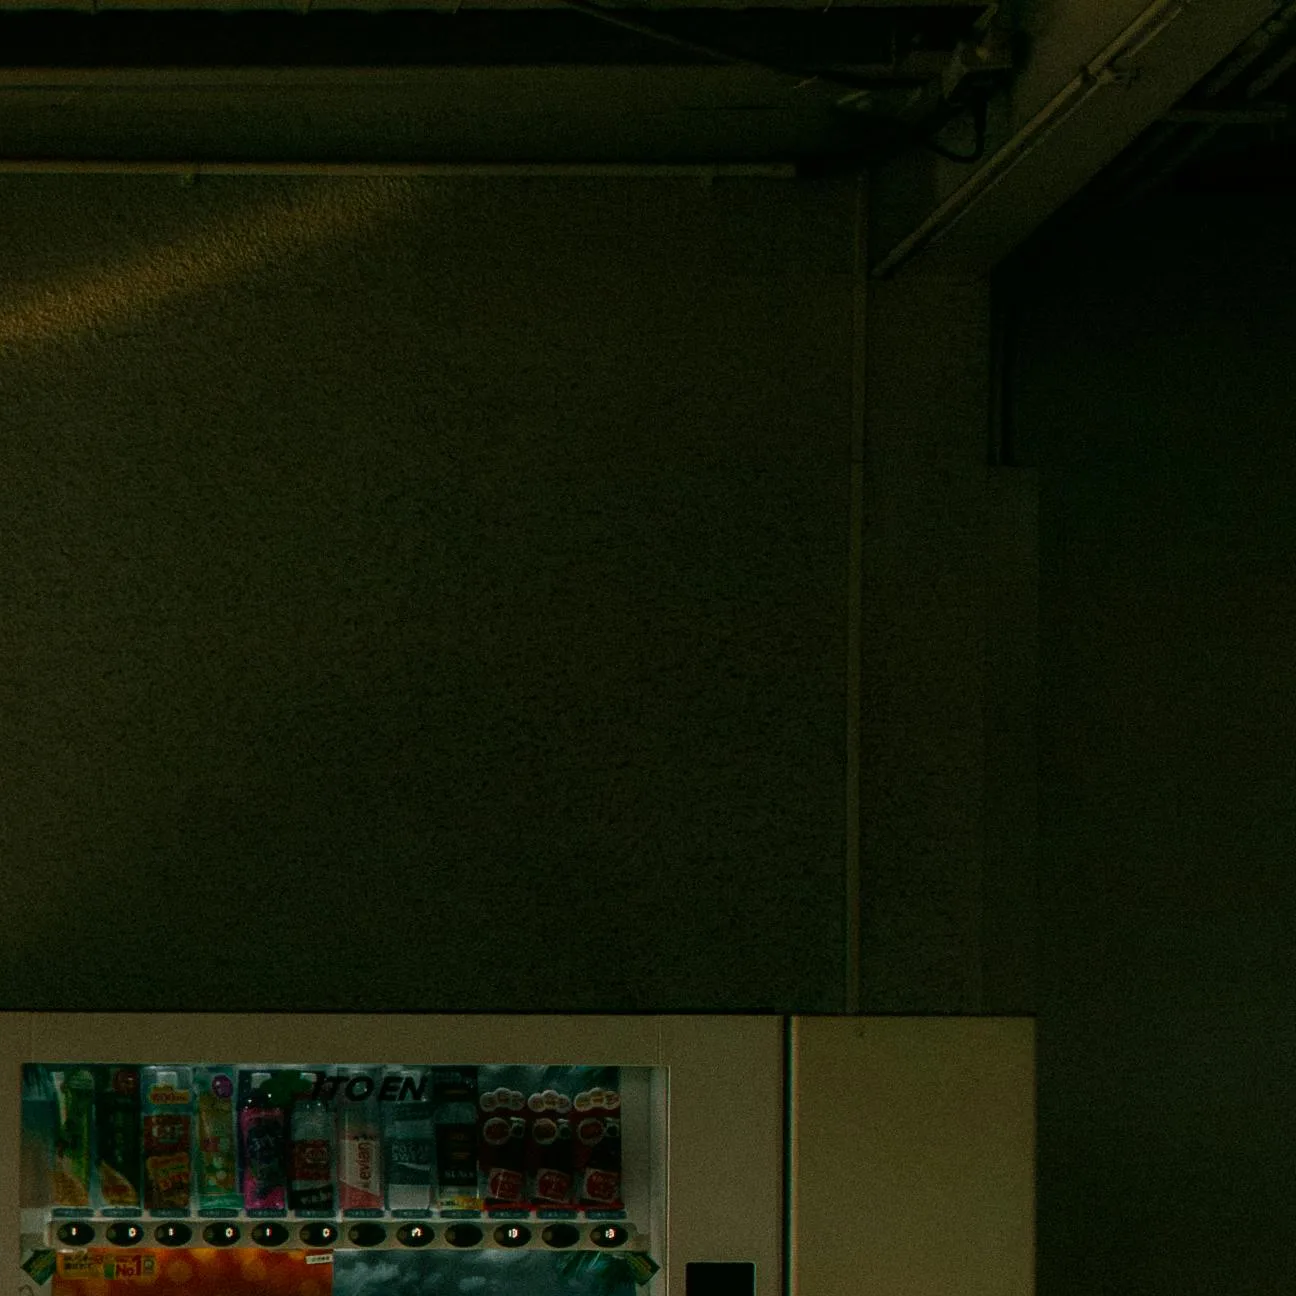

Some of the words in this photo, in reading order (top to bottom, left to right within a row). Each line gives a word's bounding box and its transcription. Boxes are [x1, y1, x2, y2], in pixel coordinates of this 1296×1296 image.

[311, 1073, 374, 1102] ITO
[378, 1073, 429, 1102] EN
[355, 1142, 372, 1181] evian
